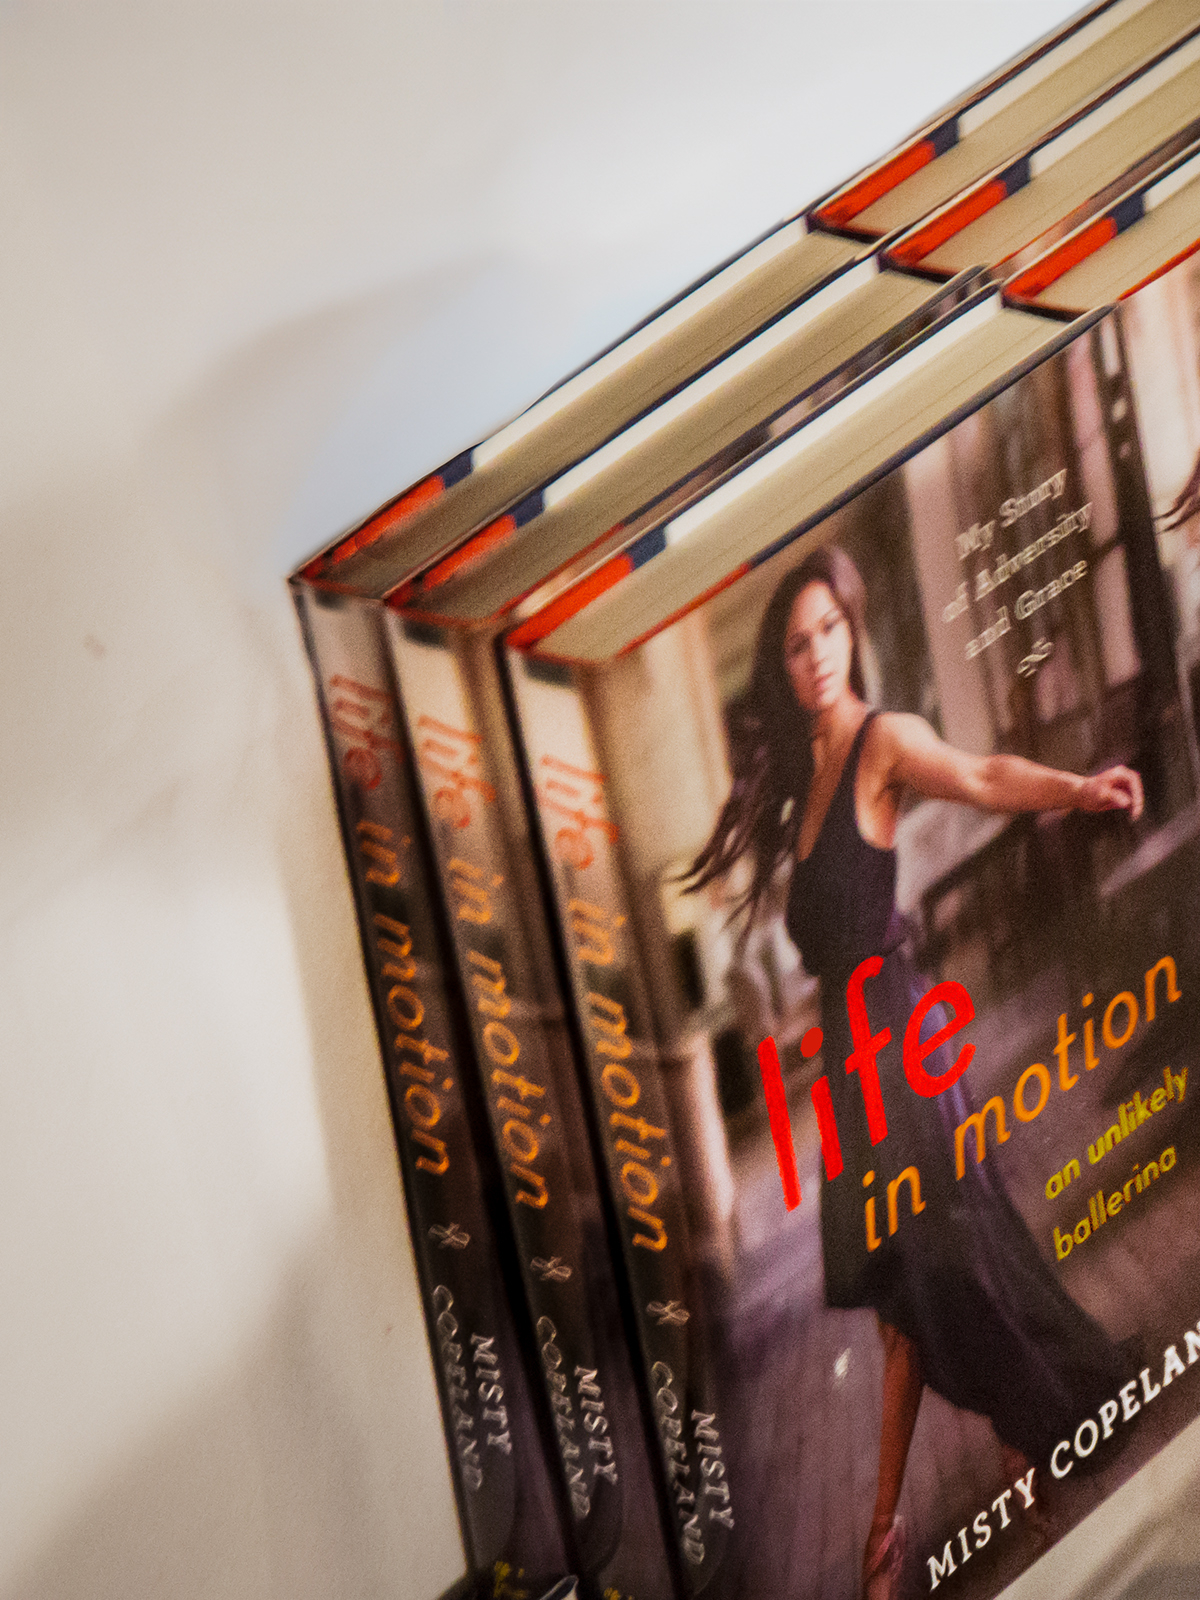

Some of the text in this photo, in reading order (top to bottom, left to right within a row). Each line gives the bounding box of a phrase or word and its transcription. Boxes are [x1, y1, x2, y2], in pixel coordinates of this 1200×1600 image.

[954, 468, 1068, 561] My Story
[975, 502, 1093, 601] Adversity
[965, 560, 1088, 660] and Grace
[330, 674, 453, 1177] life in motion
[418, 715, 551, 1210] life in motion
[539, 754, 672, 1252] life in motion
[757, 955, 976, 1212] life
[862, 956, 1182, 1252] in motion
[1045, 1066, 1189, 1200] an unlikely
[1053, 1145, 1177, 1261] ballerina
[470, 1332, 512, 1454] MISTY
[574, 1365, 618, 1485] MISTY
[691, 1409, 735, 1530] MISTY
[926, 1467, 1036, 1592] MISTY
